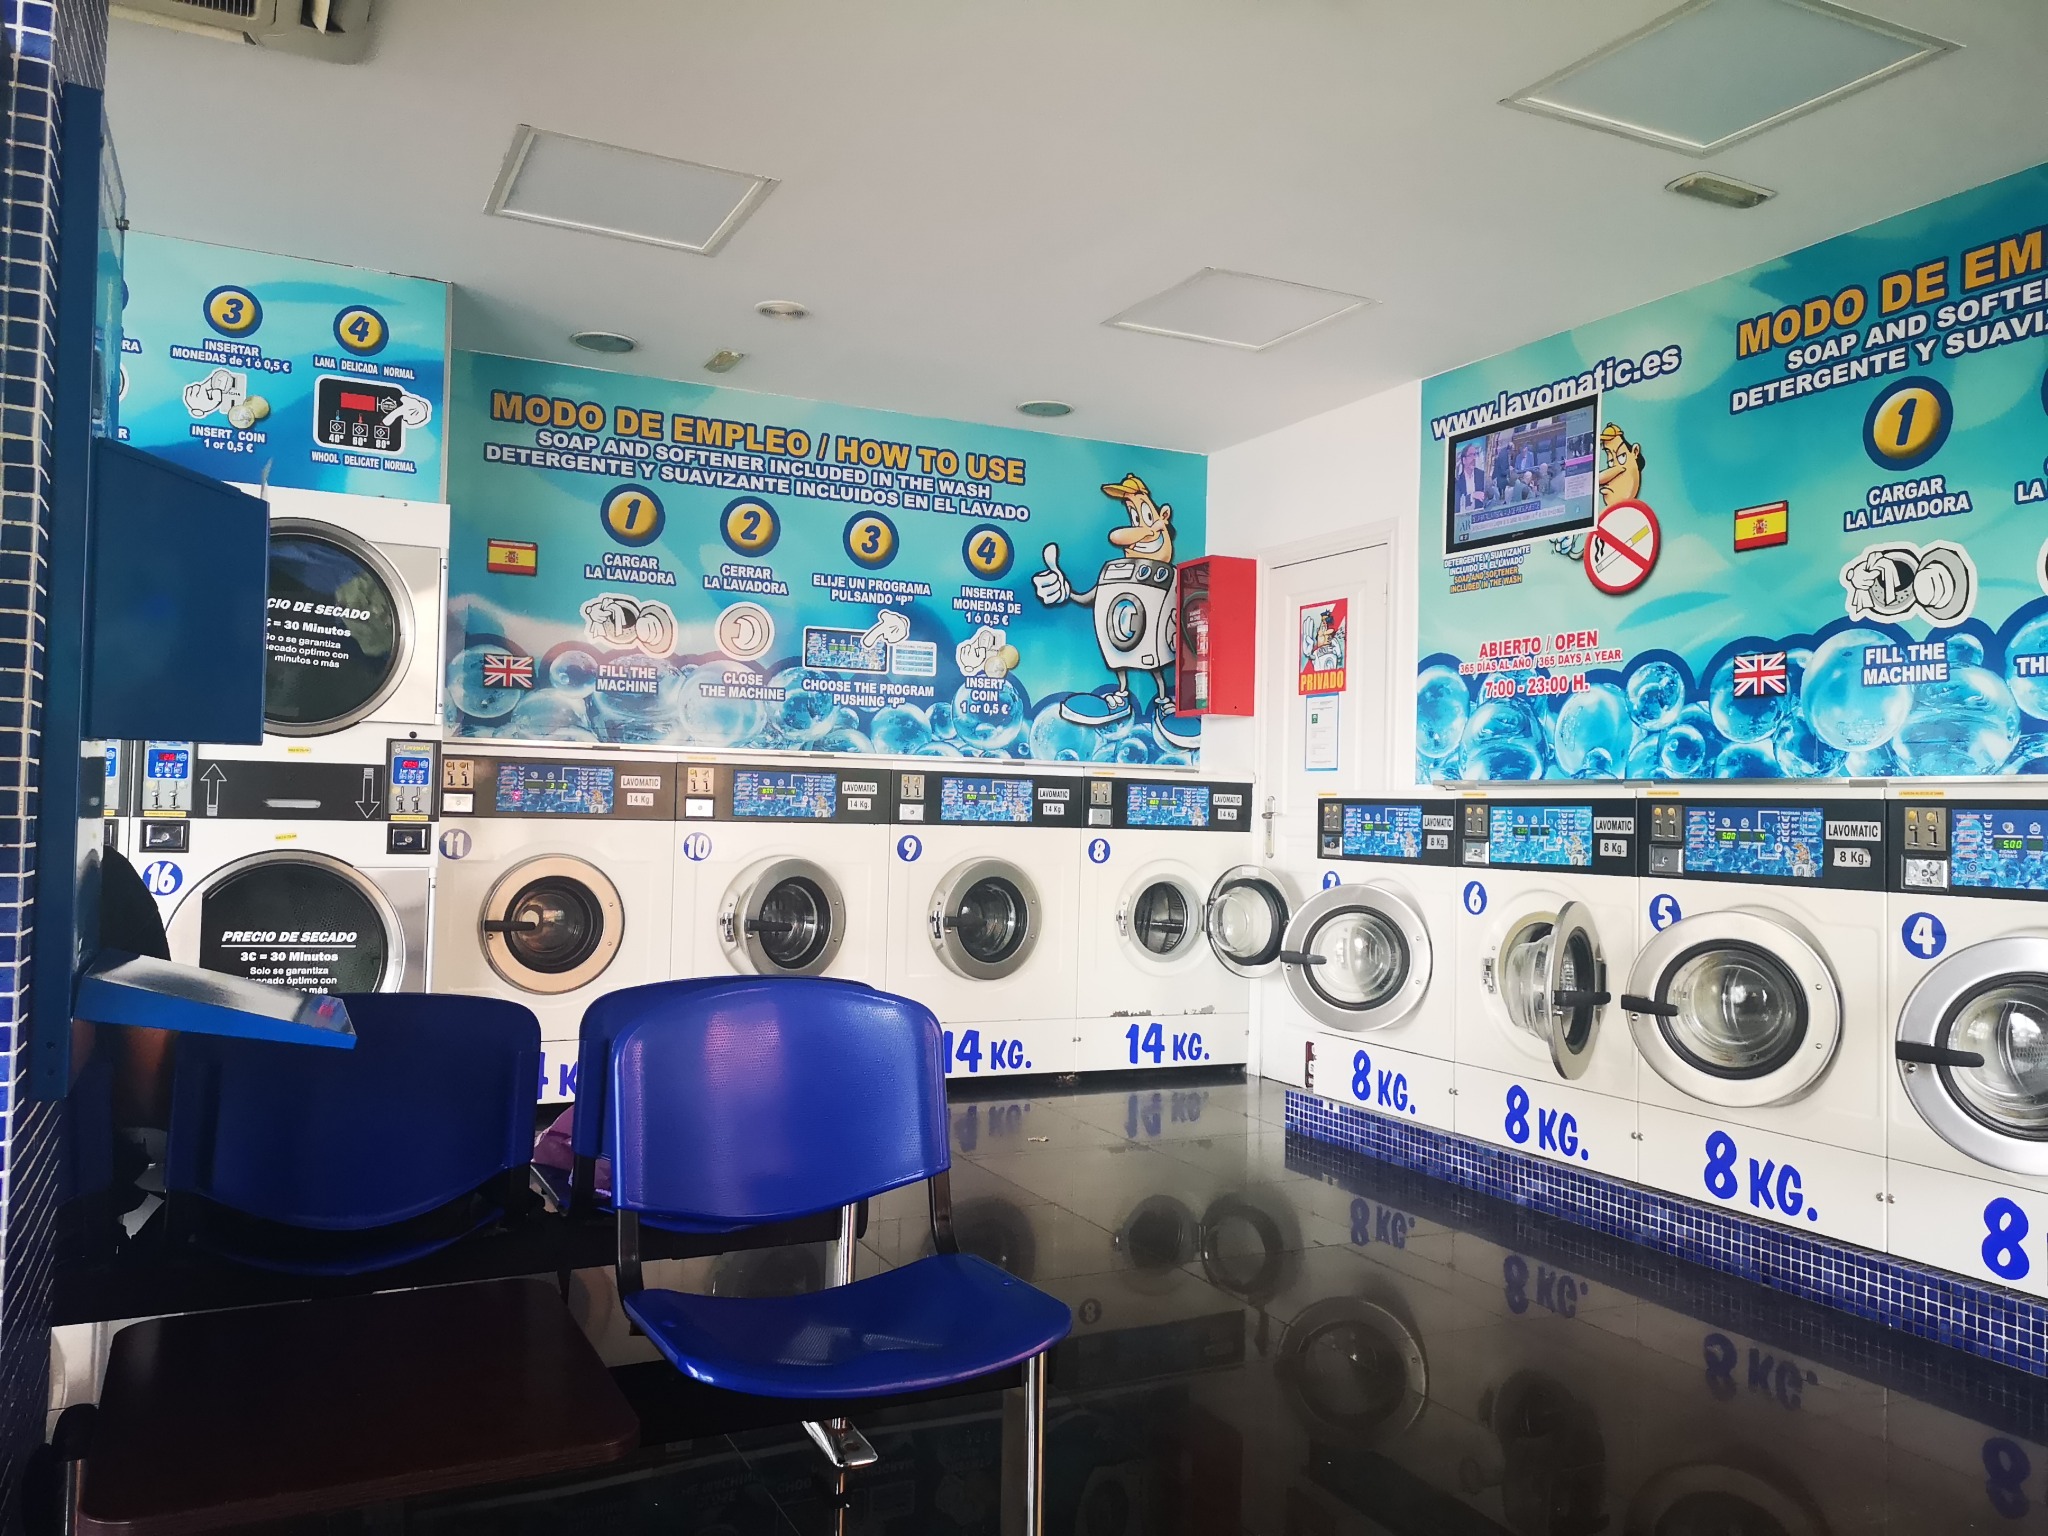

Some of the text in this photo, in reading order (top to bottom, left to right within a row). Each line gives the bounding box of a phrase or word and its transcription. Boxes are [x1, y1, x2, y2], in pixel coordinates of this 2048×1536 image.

[222, 299, 243, 324] 3
[1739, 289, 1865, 357] MODO
[1882, 262, 1946, 314] DE
[348, 317, 369, 342] 4
[1787, 278, 2048, 370] SOAP AND SOFTE
[172, 347, 226, 363] MONEDAS
[205, 341, 259, 356] INSERTAR
[315, 356, 415, 380] LANA DELICADA NORMAL
[1732, 310, 2048, 412] DETERGENTE Y SUAVI
[1432, 348, 1680, 438] www.lavomatic.es
[1896, 398, 1917, 446] 1
[192, 426, 265, 443] INSERT COIN
[493, 392, 1025, 483] MODO DE EMPLEO HOW TO USE
[311, 451, 415, 472] WHOOL DELICATE NORMAL
[538, 431, 991, 498] SOAP AND SOFTENER INCLUDED IN THE WASH
[486, 445, 1029, 520] DETERGENTE Y SUAVIZANTE INCLUIDOS EN EL LAVADO
[1868, 477, 1943, 506] CARGAR
[2018, 482, 2044, 501] LA
[626, 499, 641, 529] 1
[1846, 494, 1969, 530] LA LAVADORA
[740, 510, 761, 540] 2
[861, 525, 881, 553] 3
[976, 537, 996, 565] 4
[1444, 545, 1531, 568] DETERGENTE Y SUAVIZANTE
[604, 554, 658, 570] CARGAR
[1450, 556, 1524, 575] INCLUIDO EN EL LAVADO
[585, 565, 675, 585] LA LAVADORA
[721, 565, 771, 580] CERRAR
[1454, 567, 1519, 584] SOAP AND SOFTENER
[704, 576, 788, 594] LA LAVADORA
[813, 574, 931, 595] ELIJE UN PROGRAMA
[961, 587, 1014, 601] INSERTAR
[1451, 575, 1522, 593] INCLUDED IN THE WASH
[831, 589, 893, 604] PULSANDO
[953, 598, 1021, 614] MONEDAS DE
[293, 601, 370, 621] DE SECADO
[284, 620, 300, 630] 30
[302, 622, 351, 637] Minutos
[1479, 630, 1599, 659] ABIERTO OPEN
[1865, 642, 1945, 665] FILL THE
[599, 665, 657, 679] FILL THE
[1460, 663, 1475, 675] 365
[1499, 659, 1511, 670] AL
[1512, 656, 1531, 670] AÑO
[1539, 654, 1555, 667] 365
[1558, 652, 1583, 665] DAYS
[1584, 652, 1592, 663] A
[1595, 649, 1622, 662] YEAR
[723, 672, 763, 686] CLOSE
[965, 677, 1005, 690] INSERT
[1300, 671, 1344, 691] PRIVADO
[1863, 663, 1948, 685] MACHINE
[596, 679, 657, 693] MACHINE
[700, 684, 785, 700] THE MACHINE
[802, 678, 934, 697] CHOOSE THE PROGRAM
[971, 690, 998, 702] COIN
[1485, 674, 1590, 698] 7:00 23:00 H.
[833, 693, 885, 707] PUSHING
[622, 777, 659, 787] LAVOMATIC
[843, 783, 876, 793] LAVOMATIC
[849, 800, 858, 808] 14
[1039, 790, 1068, 799] LAVOMATIC
[1214, 796, 1241, 804] LAVOMATIC
[1424, 817, 1452, 828] LAVOMATIC
[1595, 820, 1632, 831] LAVOMATIC
[1828, 824, 1878, 838] LAVOMATIC
[444, 833, 465, 856] 11
[686, 834, 710, 859] 10
[903, 837, 917, 860] 9
[1603, 842, 1610, 852] 8
[1839, 851, 1847, 862] 8
[148, 864, 176, 894] 16
[1469, 884, 1481, 913] 6
[1658, 897, 1673, 929] 5
[222, 931, 357, 943] PRECIO DE SECADO
[1910, 916, 1936, 955] 4
[270, 952, 339, 962] 30 Minutos
[250, 966, 329, 976] Solo garantiza
[287, 976, 318, 986] óptimo
[944, 1030, 1031, 1073] 14 KG.
[1127, 1024, 1210, 1064] 14 KG.
[1352, 1050, 1371, 1101] 8
[1378, 1070, 1416, 1115] KG.
[1505, 1084, 1589, 1161] 8 KG.
[1704, 1130, 1818, 1222] 8 KG.
[1981, 1197, 2030, 1280] 8
